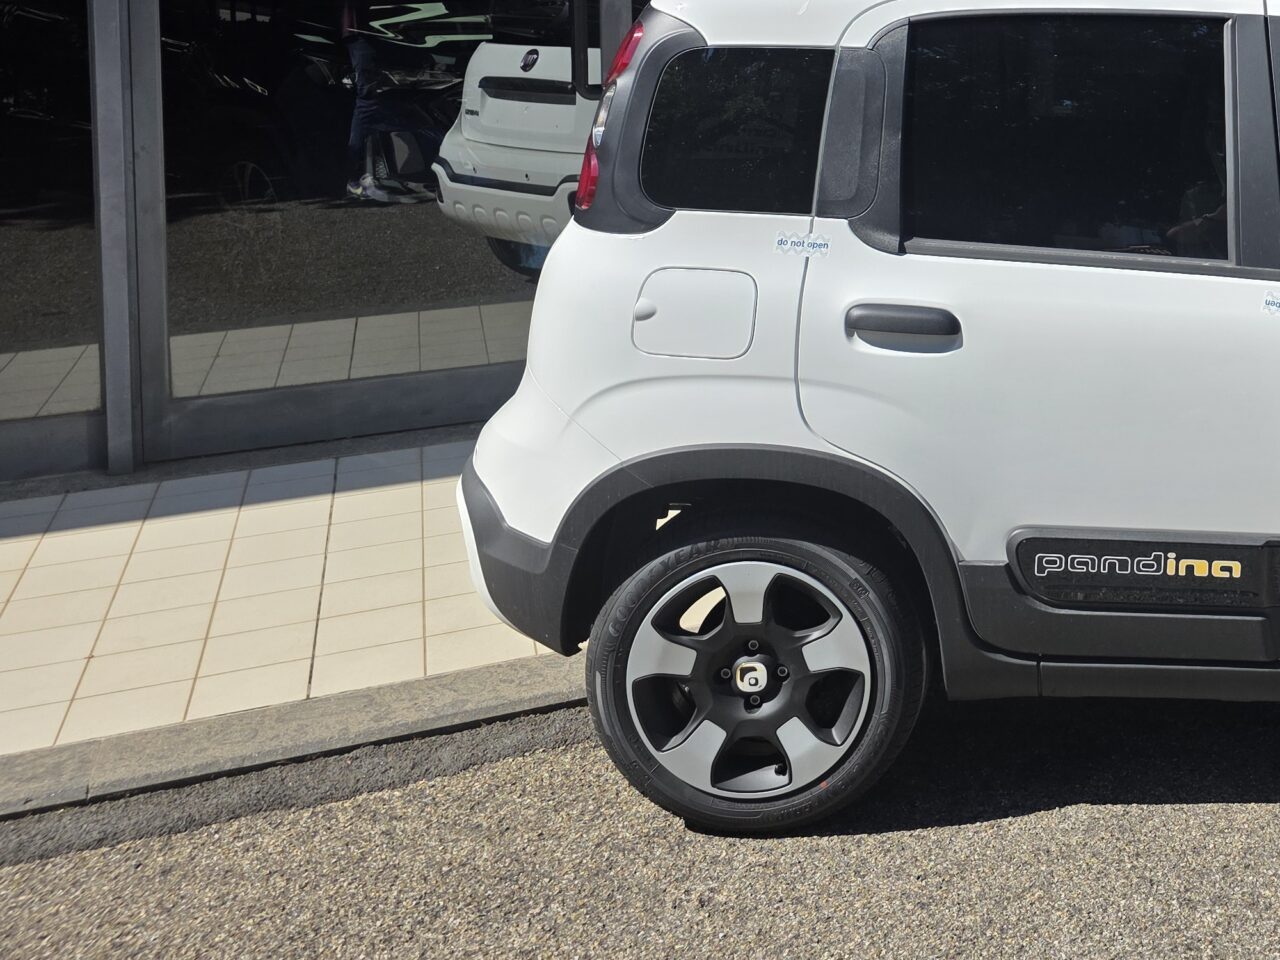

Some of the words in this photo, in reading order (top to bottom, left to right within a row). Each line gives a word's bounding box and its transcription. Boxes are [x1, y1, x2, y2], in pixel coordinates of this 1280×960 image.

[777, 238, 789, 246] do
[790, 239, 805, 248] not
[807, 241, 829, 249] open
[1034, 552, 1242, 578] pandina
